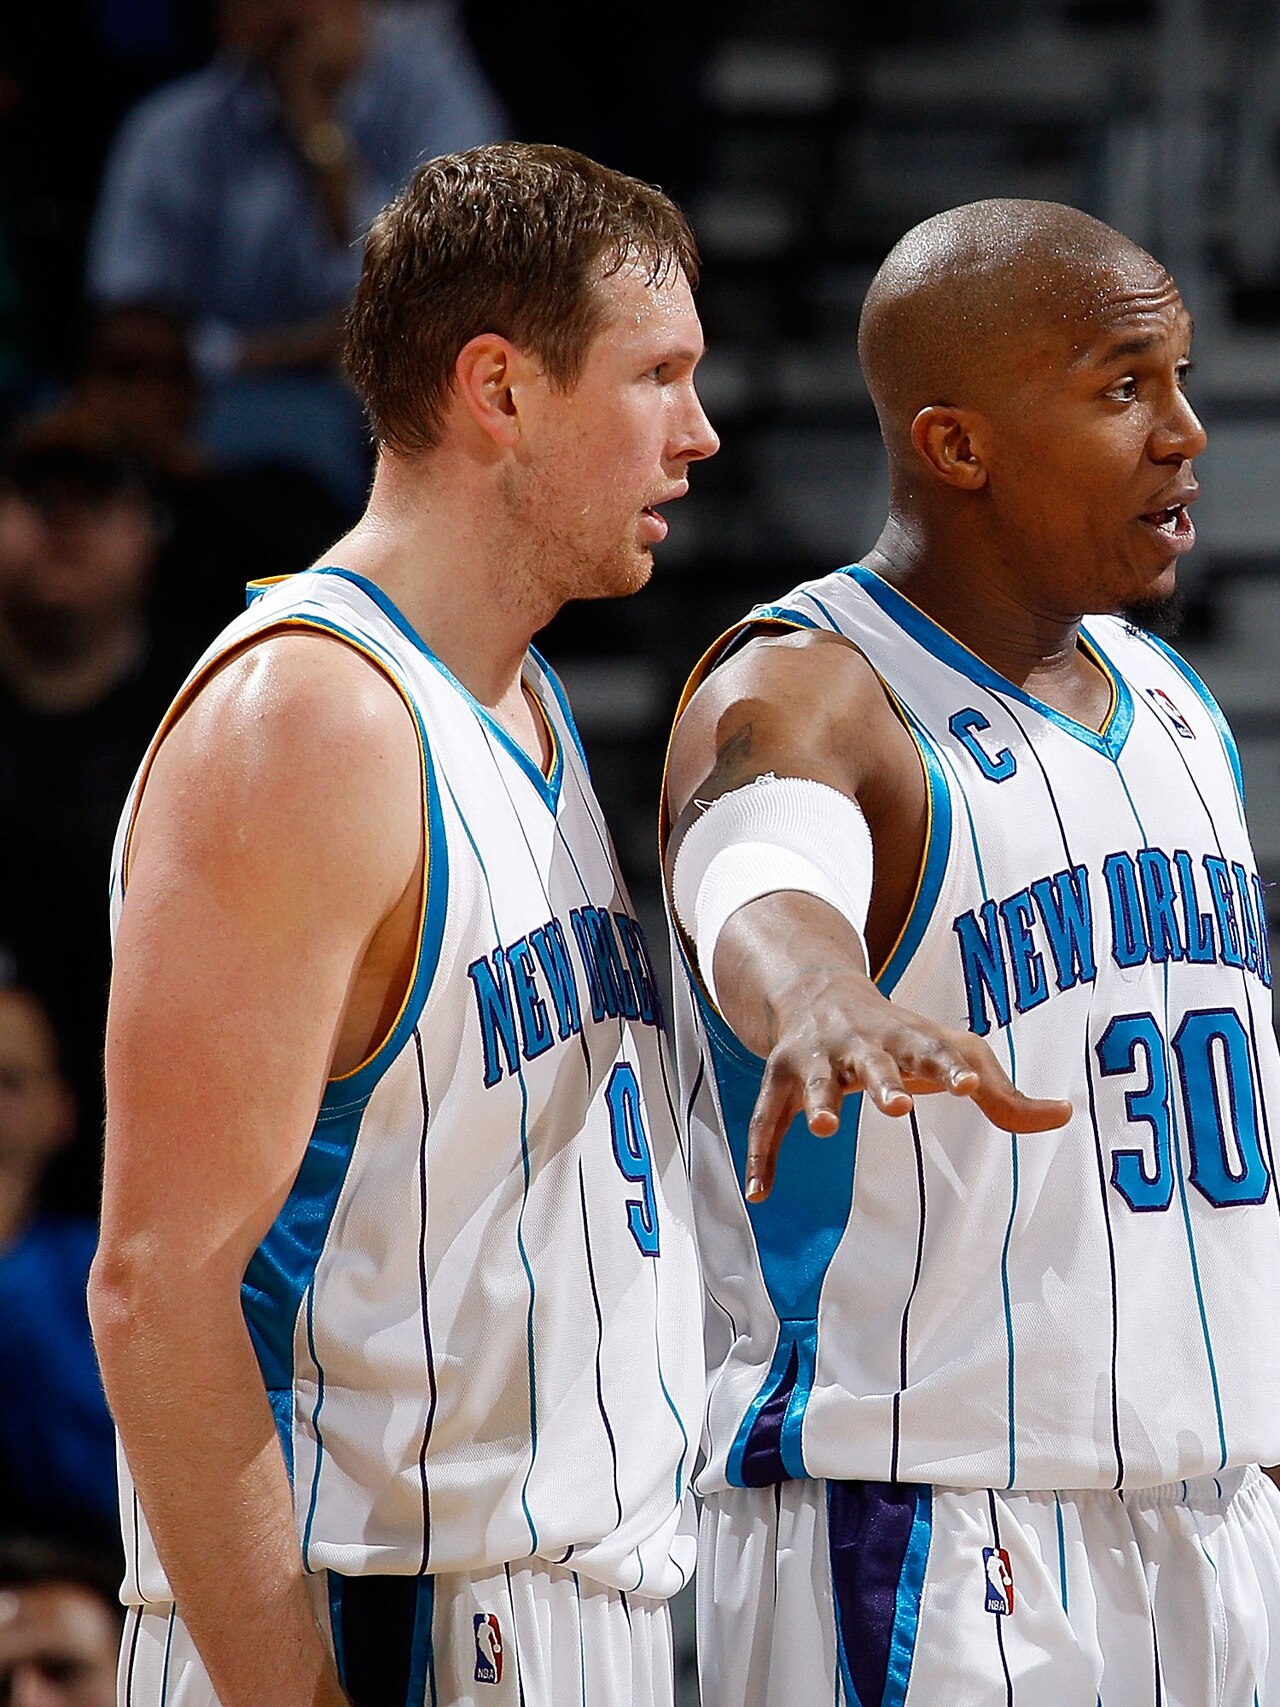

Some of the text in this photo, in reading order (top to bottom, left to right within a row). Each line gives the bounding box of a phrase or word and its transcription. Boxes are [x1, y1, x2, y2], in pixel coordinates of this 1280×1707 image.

[949, 707, 1016, 783] C
[468, 905, 666, 1088] NEW ORLE
[953, 864, 1096, 1037] NEW
[605, 1061, 661, 1258] 9
[1094, 1008, 1271, 1213] 30
[477, 1667, 494, 1679] NBA
[987, 1599, 1005, 1612] NBA
